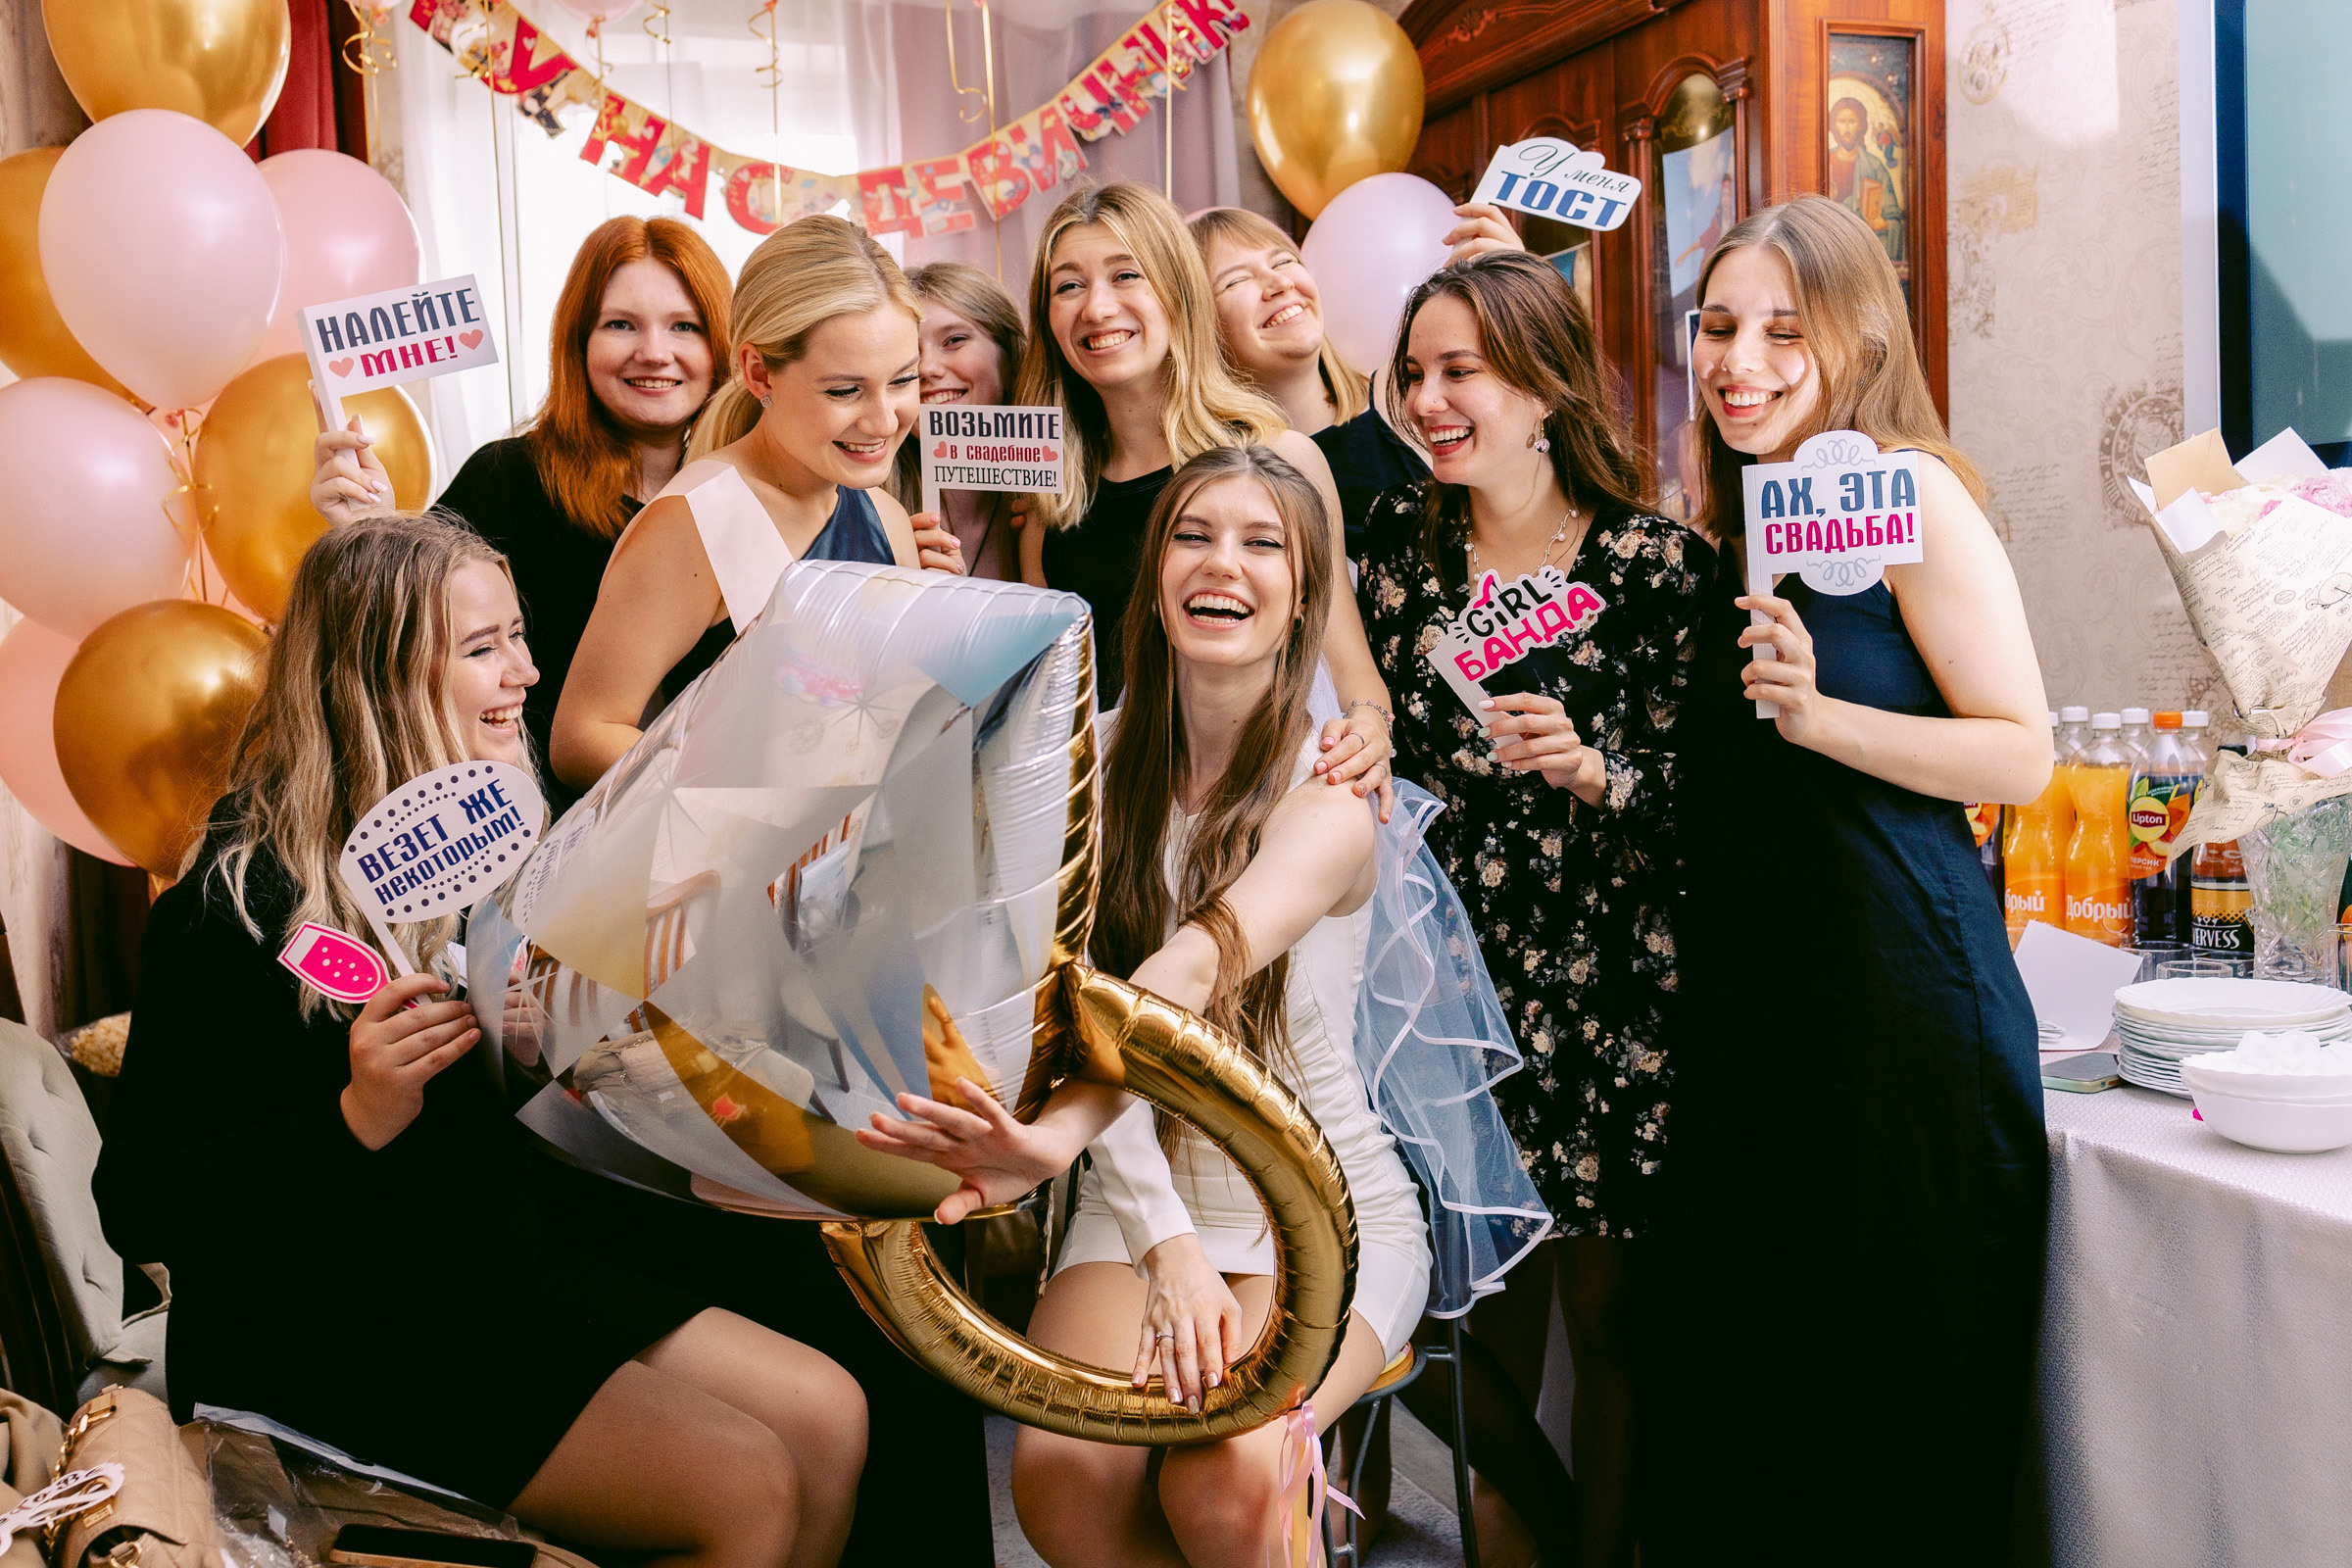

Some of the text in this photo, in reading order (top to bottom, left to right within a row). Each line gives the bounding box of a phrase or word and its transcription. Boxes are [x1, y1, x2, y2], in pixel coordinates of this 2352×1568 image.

[1519, 144, 1631, 193] У меня
[1495, 171, 1627, 227] ТОСТ
[316, 287, 480, 354] НАЛЕЙТЕ
[360, 335, 459, 377] МНЕ!
[929, 411, 1059, 439] ВОЗЬМИТЕ
[966, 444, 1041, 463] свадебное
[934, 466, 1057, 487] ПУТЕШЕСТВИЕ!
[1761, 467, 1916, 518] АХ, ЭТА
[1765, 512, 1915, 555] СВАДЬБА!
[1453, 586, 1601, 682] БАНДА
[357, 778, 513, 883] ВЕЗЕТ ЖЕ
[2132, 812, 2163, 825] Lipton
[2067, 894, 2133, 923] Добрый
